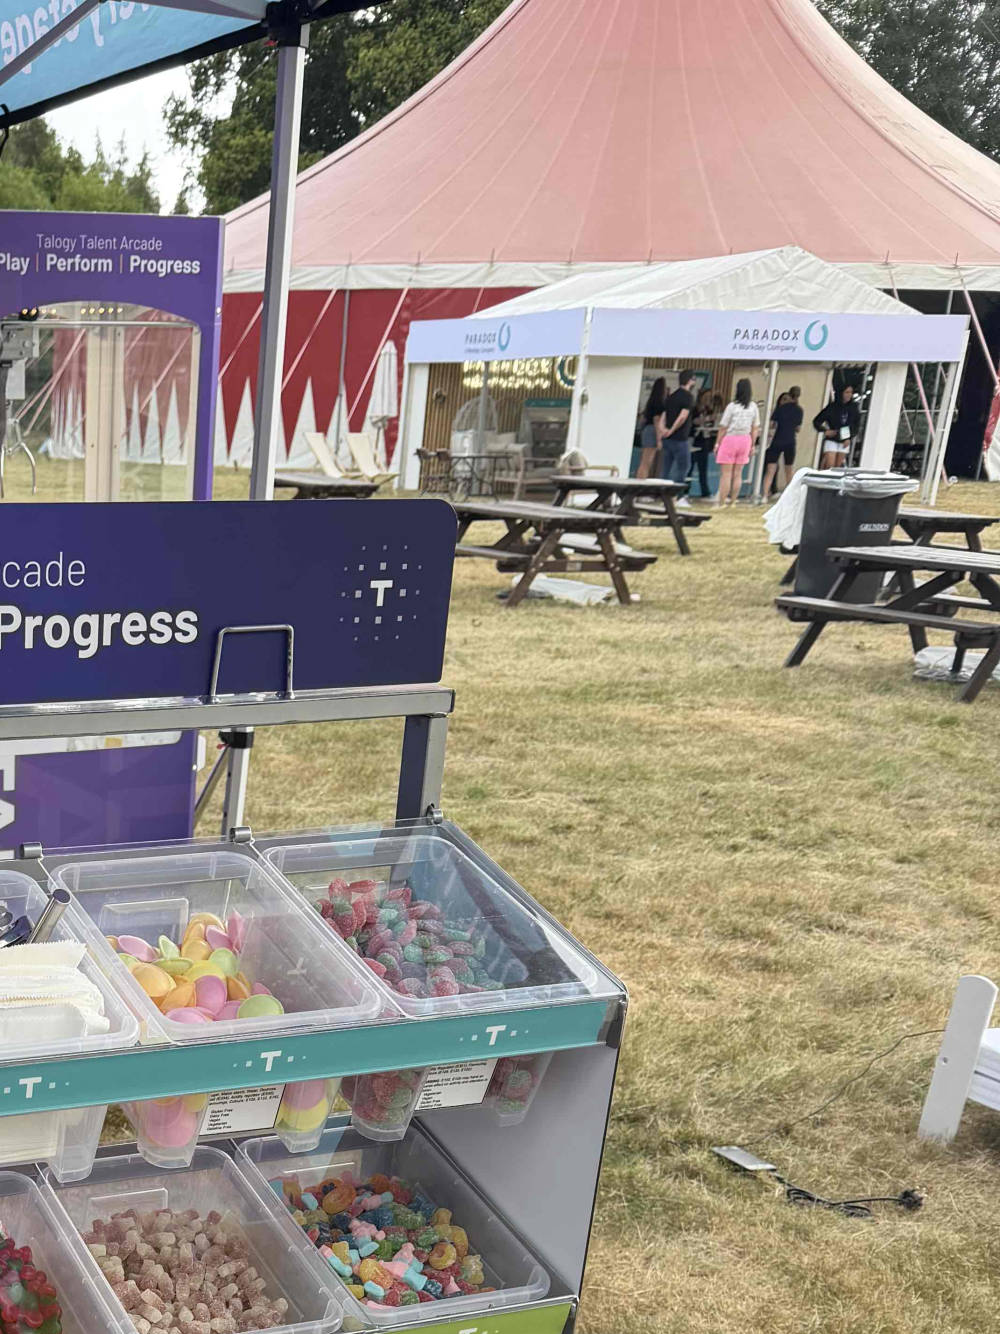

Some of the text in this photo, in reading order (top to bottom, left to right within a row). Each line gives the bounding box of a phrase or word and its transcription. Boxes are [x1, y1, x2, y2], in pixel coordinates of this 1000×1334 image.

[36, 234, 163, 252] Talogy Talent Arcade
[46, 254, 113, 273] Perform
[129, 255, 201, 278] Progress
[733, 328, 800, 341] PARADOX
[767, 343, 797, 352] Company
[370, 579, 393, 606] T
[485, 1025, 507, 1046] T
[260, 1050, 282, 1072] T
[18, 1077, 42, 1099] T
